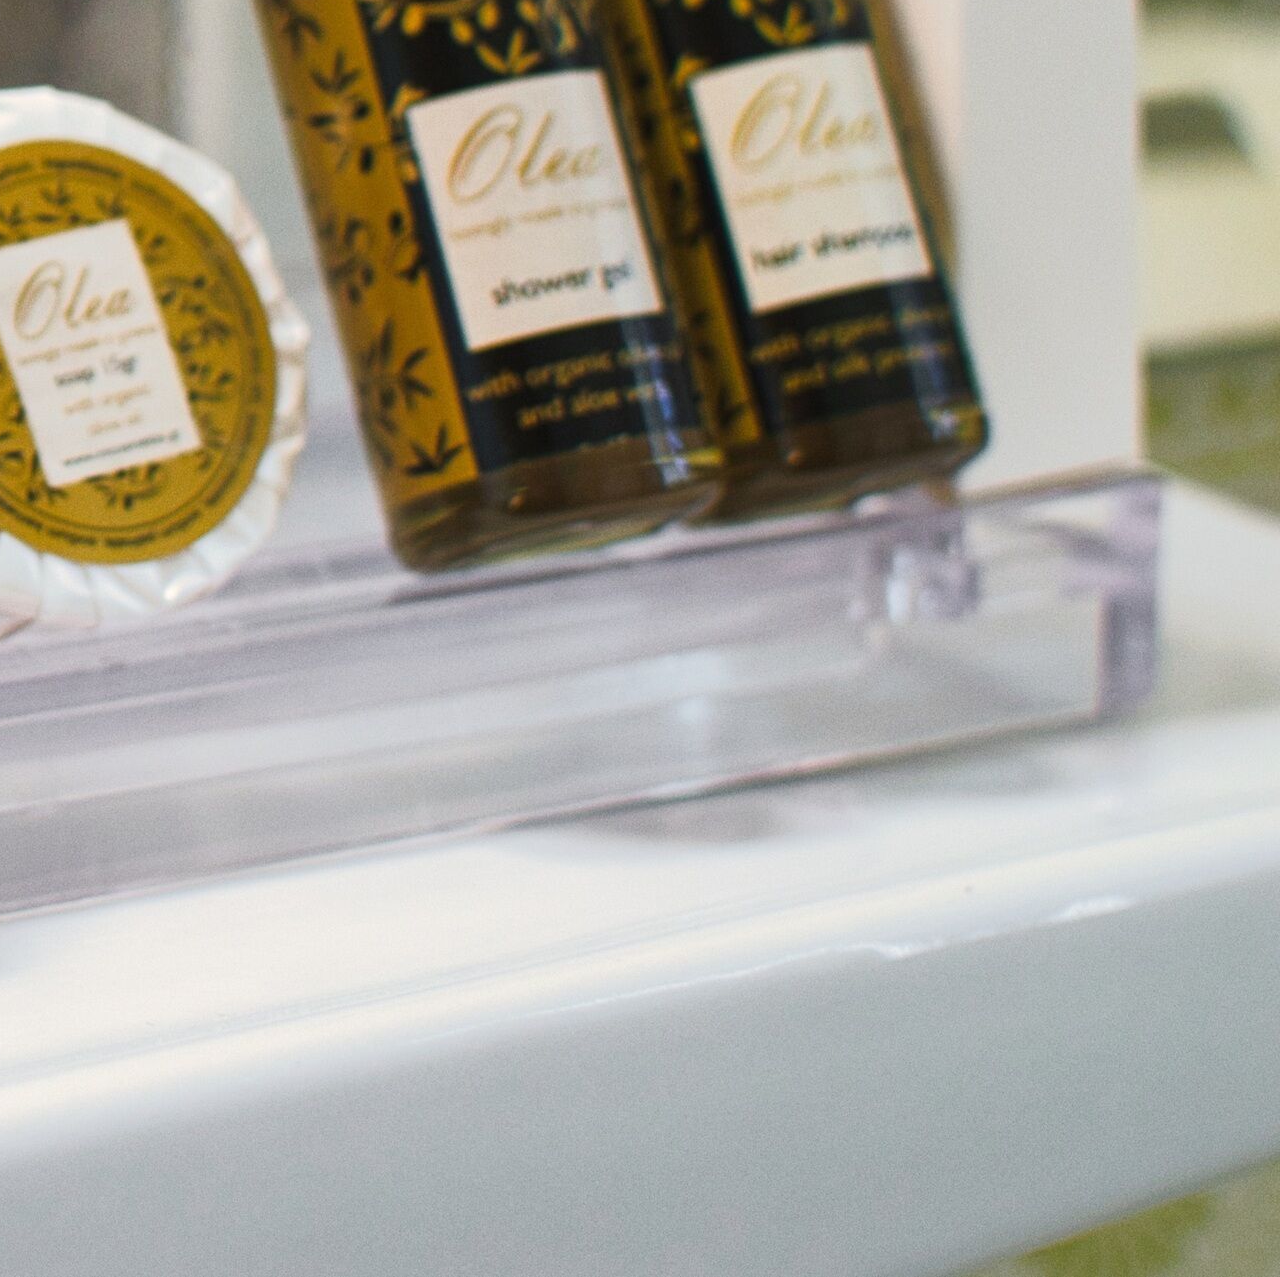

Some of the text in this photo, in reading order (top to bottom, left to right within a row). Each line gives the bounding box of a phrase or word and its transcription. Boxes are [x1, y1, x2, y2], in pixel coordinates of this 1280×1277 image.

[446, 102, 604, 206] Olea
[13, 259, 137, 342] Olea
[492, 269, 590, 306] shower
